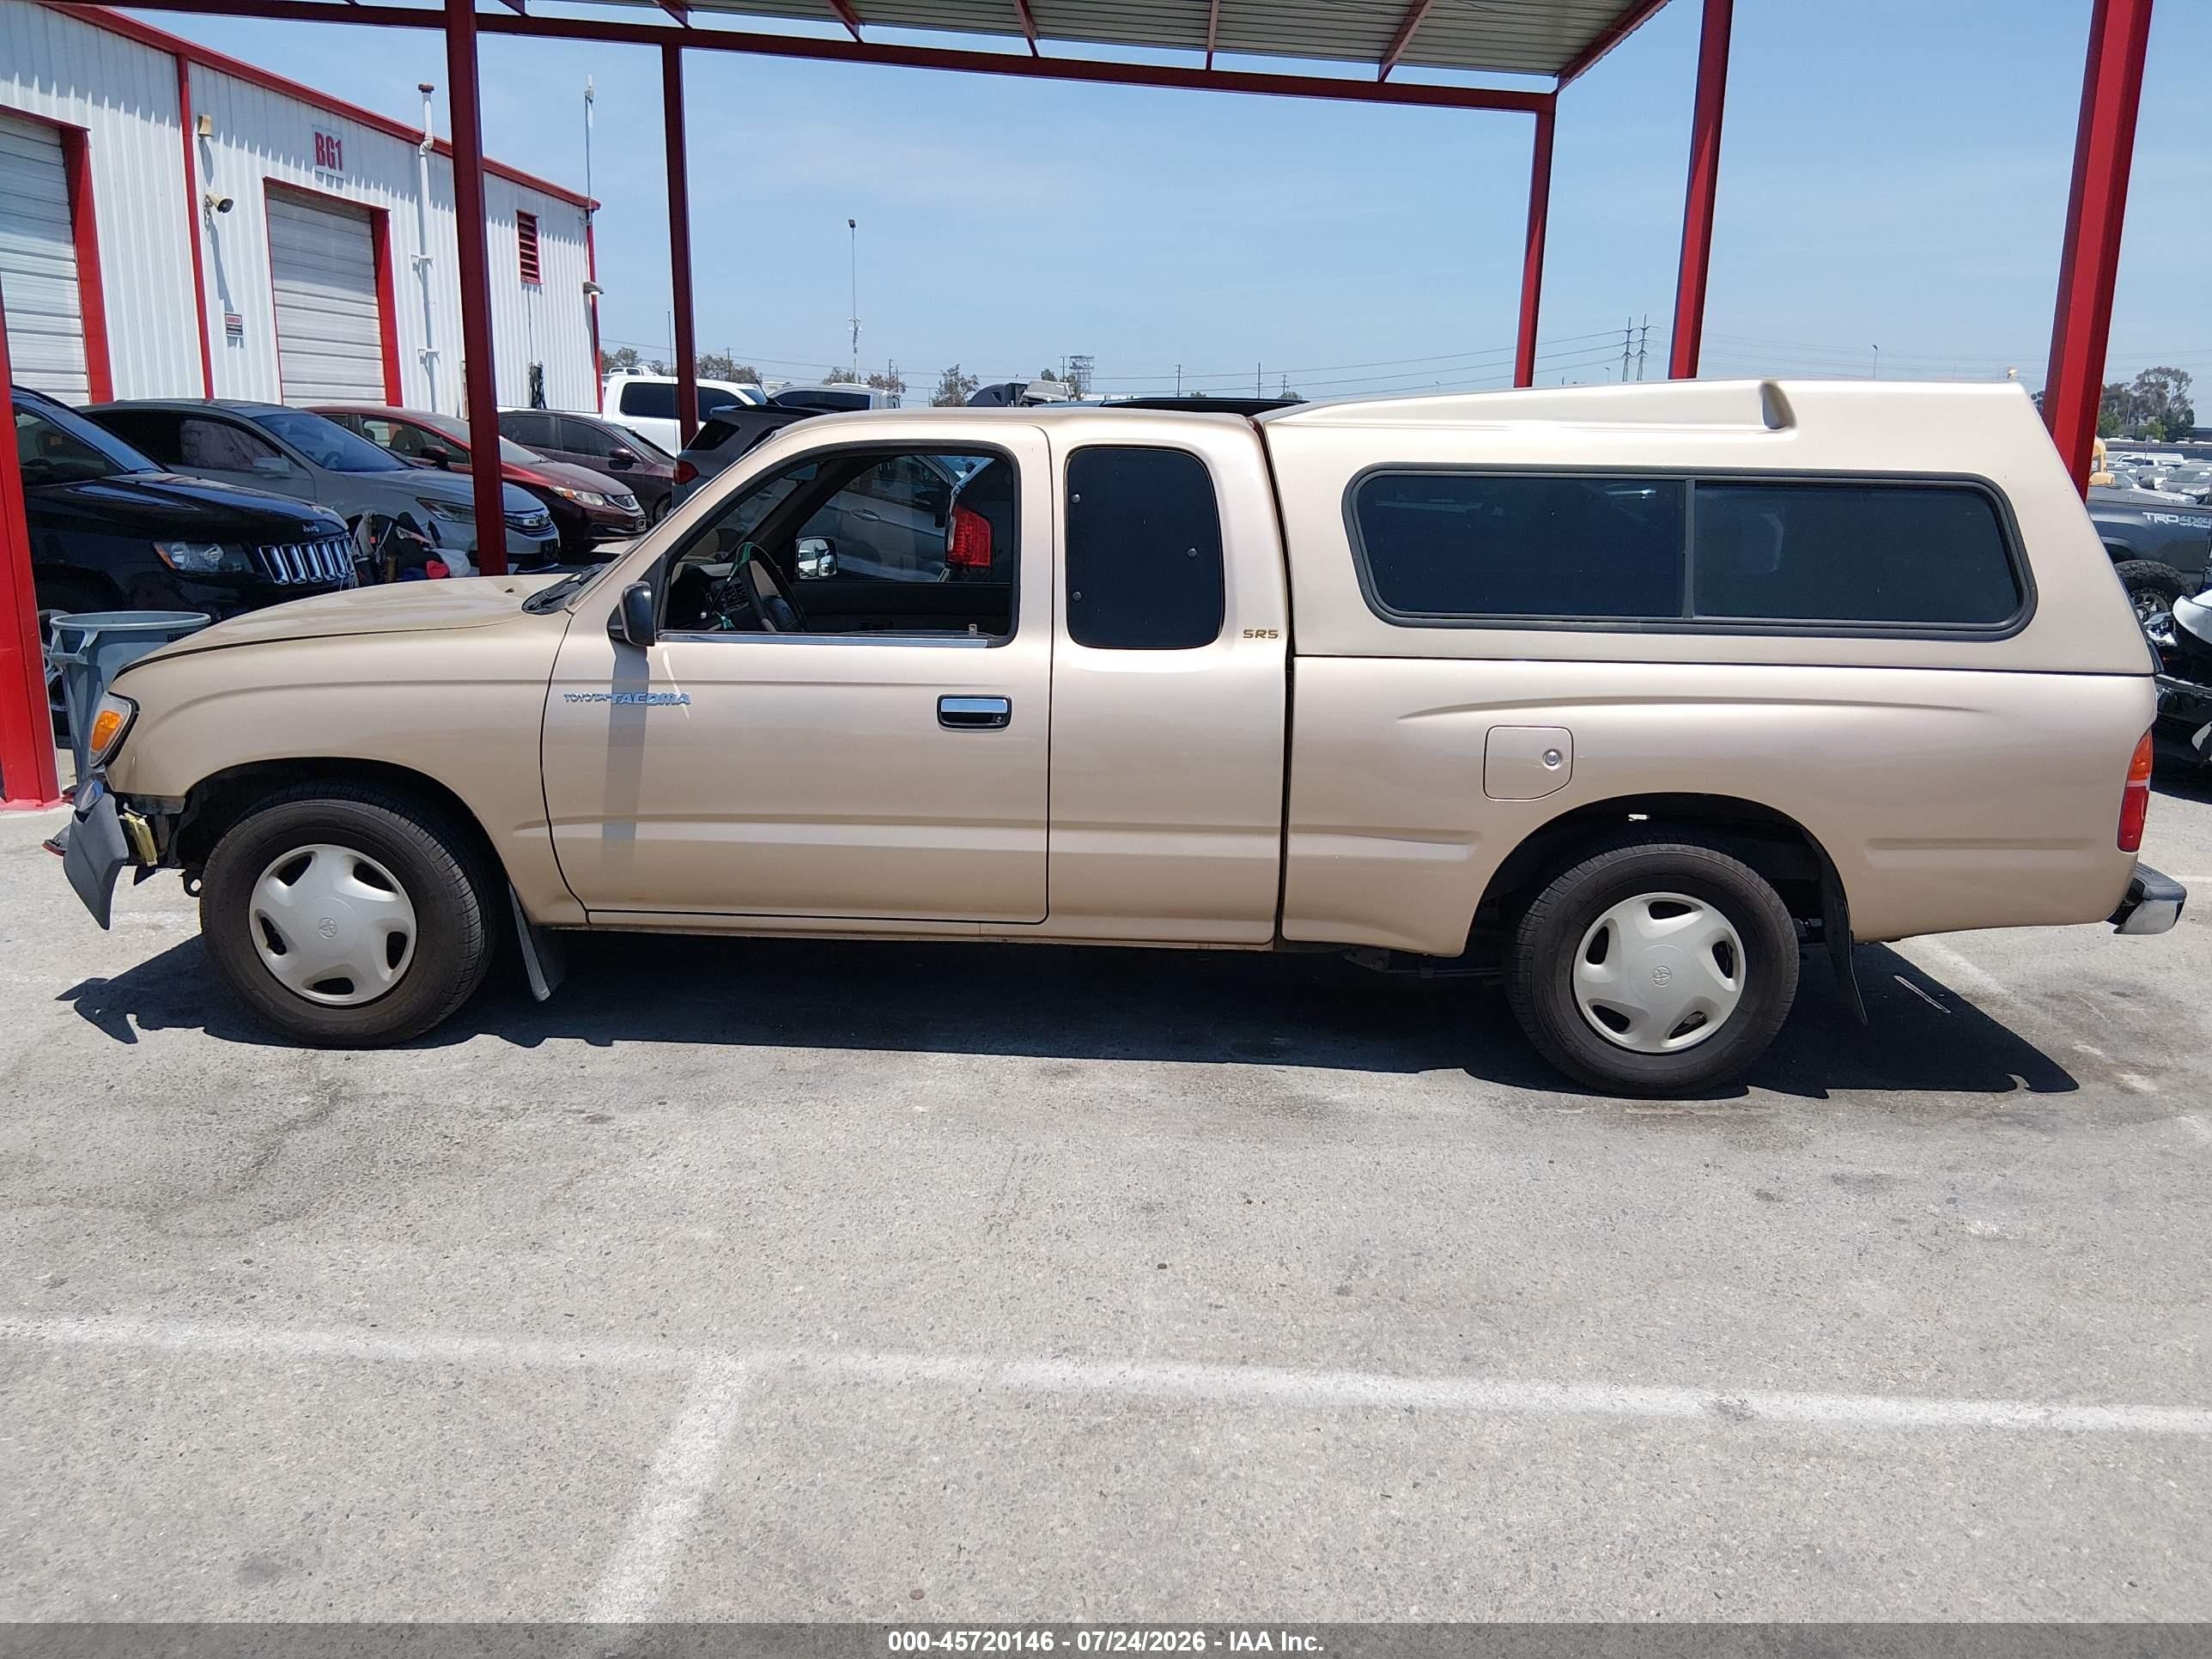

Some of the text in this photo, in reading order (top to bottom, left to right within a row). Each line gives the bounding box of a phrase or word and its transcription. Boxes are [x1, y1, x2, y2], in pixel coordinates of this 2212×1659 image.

[314, 131, 343, 172] BG1
[2142, 512, 2179, 524] TRD
[563, 693, 691, 706] TOYOTA TACOMA
